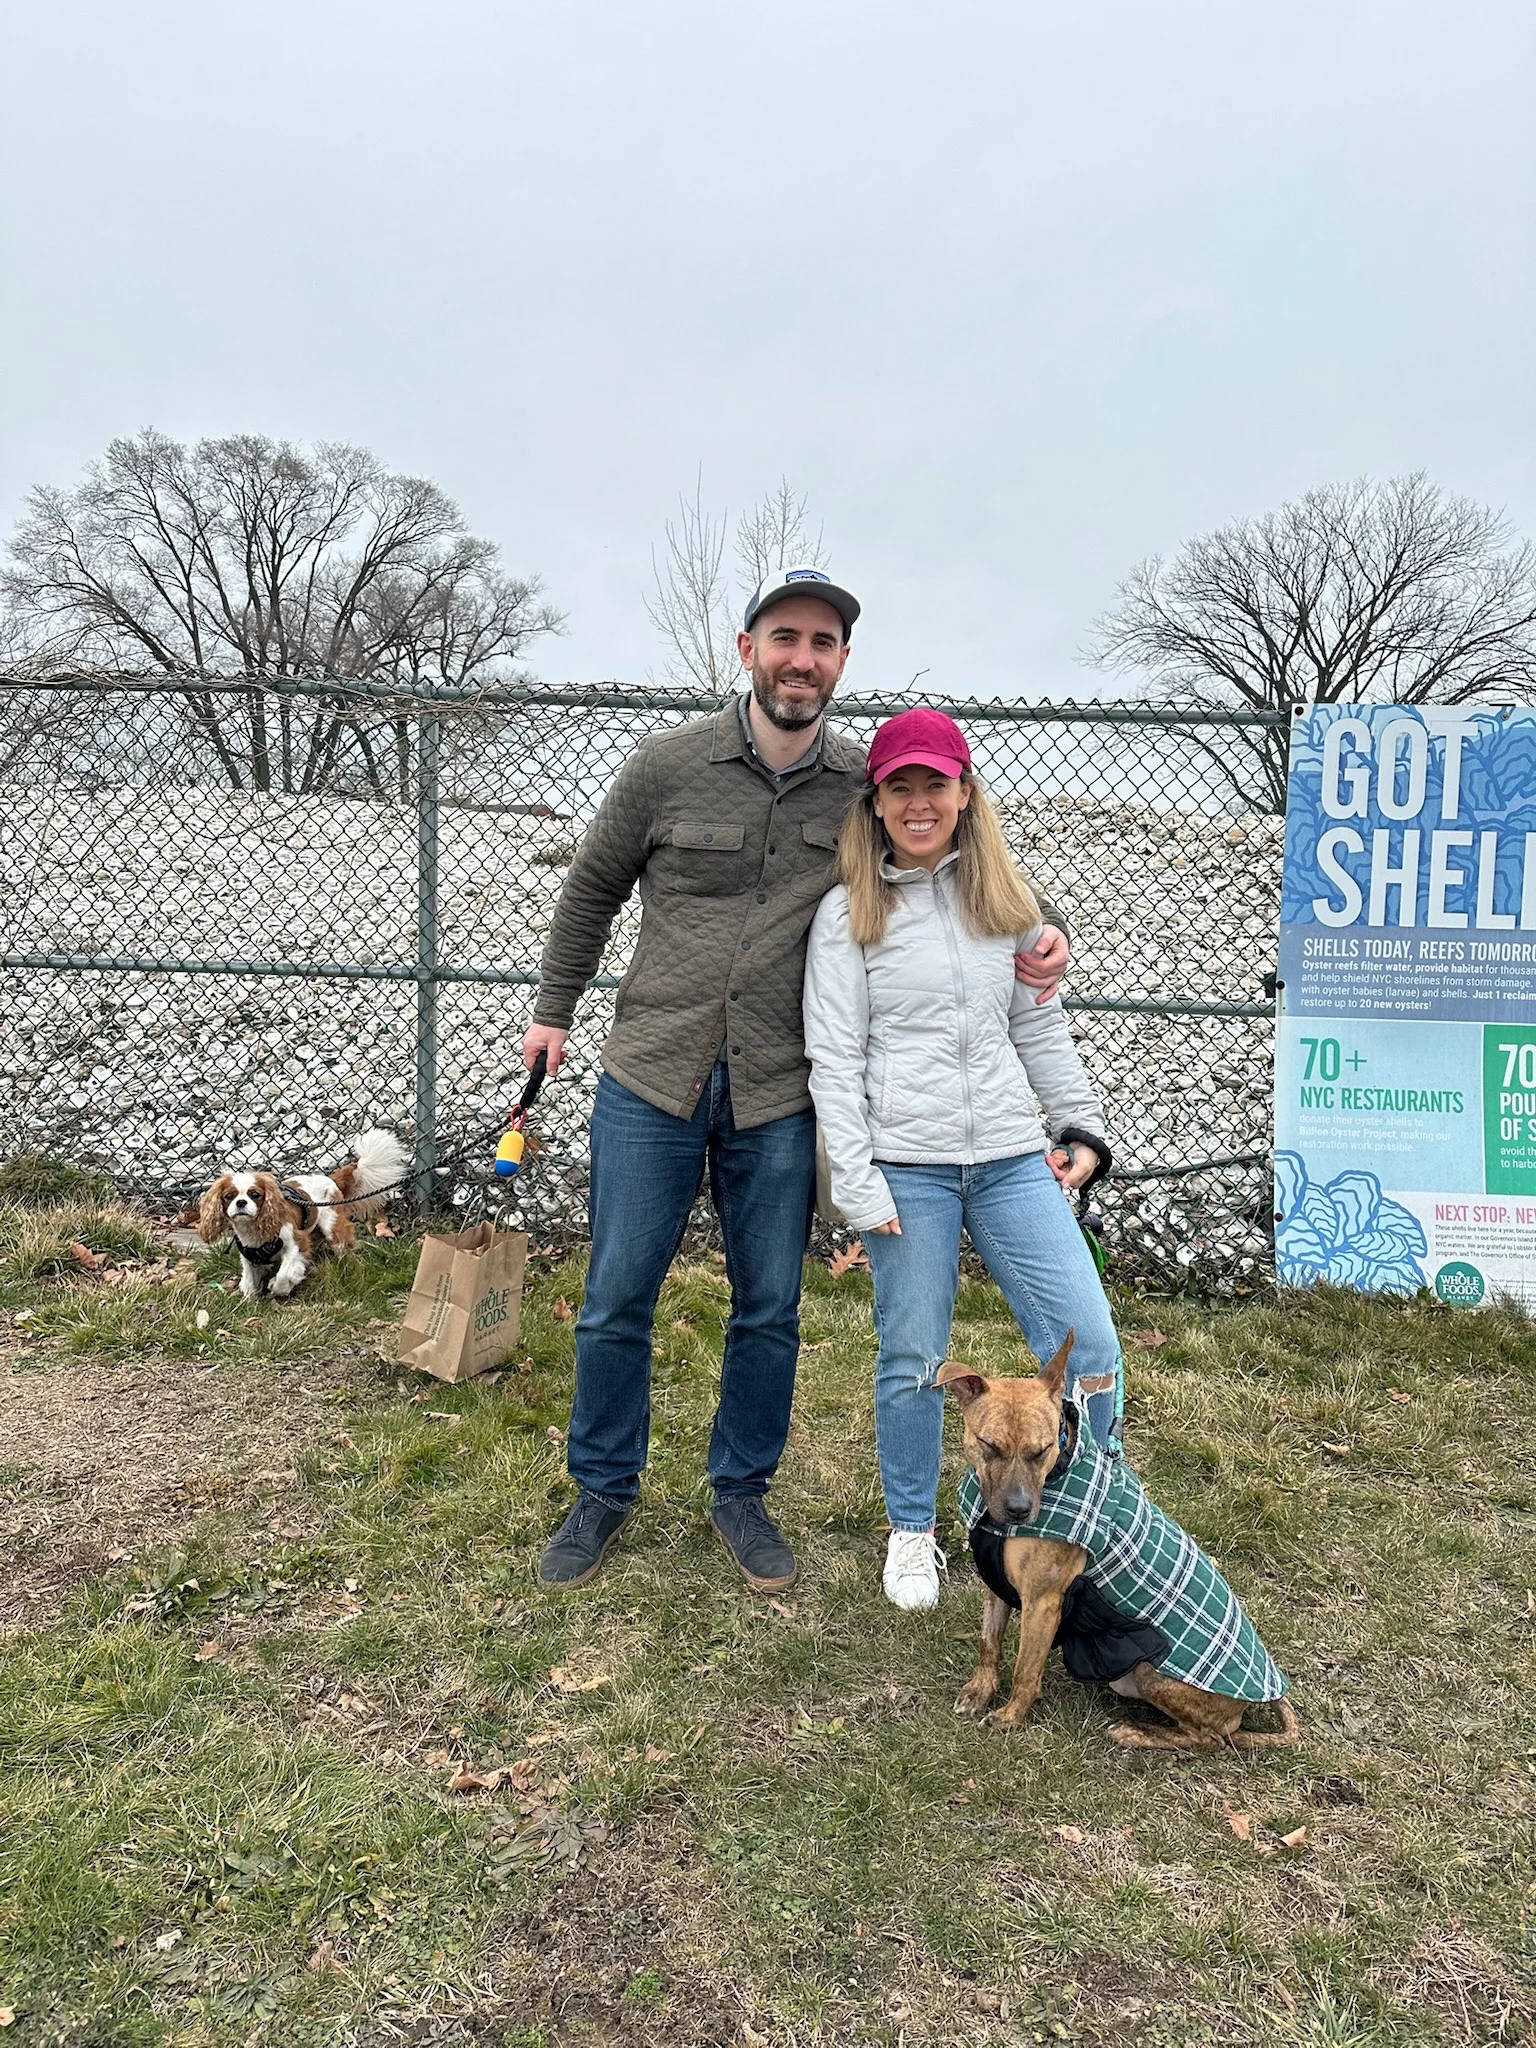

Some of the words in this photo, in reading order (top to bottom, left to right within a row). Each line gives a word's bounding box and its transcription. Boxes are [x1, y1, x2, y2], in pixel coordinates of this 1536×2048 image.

[1321, 718, 1478, 820] GOT
[1303, 938, 1359, 958] SHELLS
[1364, 940, 1412, 961] TODAY,
[1420, 941, 1464, 960] REEFS
[1302, 960, 1332, 971] Oyster
[1334, 961, 1358, 970] reefs
[1361, 961, 1383, 971] filter
[1386, 963, 1412, 973] water,
[1415, 963, 1449, 974] provide
[1451, 964, 1483, 974] habitat
[1486, 964, 1498, 974] for
[1302, 973, 1318, 982] and
[1321, 973, 1340, 984] help
[1342, 974, 1369, 983] shield
[1372, 974, 1391, 984] NYC
[1394, 975, 1440, 985] shorelines
[1443, 976, 1463, 985] from
[1466, 978, 1492, 986] storm
[1494, 978, 1533, 989] damage.
[1301, 986, 1320, 994] with
[1322, 987, 1351, 996] oyster
[1353, 987, 1382, 996] babies
[1386, 987, 1420, 998] (larvae)
[1422, 989, 1439, 997] and
[1441, 989, 1470, 998] shells.
[1472, 990, 1493, 999] Just
[1495, 990, 1500, 999] 1
[1301, 998, 1332, 1007] restore
[1335, 1000, 1346, 1009] up
[1360, 999, 1371, 1008] 20
[1395, 1001, 1432, 1011] oysters!
[1301, 1086, 1334, 1109] NYC
[1342, 1088, 1464, 1113] RESTAURANTS
[1300, 1126, 1328, 1135] Billion
[1331, 1128, 1360, 1138] Oyster
[1364, 1129, 1398, 1140] Project,
[1401, 1131, 1433, 1142] making
[1436, 1132, 1451, 1140] our
[1500, 1118, 1523, 1140] OF
[1351, 1141, 1372, 1150] work
[1501, 1147, 1524, 1155] avoid
[1435, 1205, 1468, 1221] NEXT
[1473, 1206, 1510, 1223] STOP:
[1440, 1274, 1479, 1286] WHOLE
[1442, 1285, 1479, 1295] FOODS
[475, 1288, 510, 1317] WHOLE
